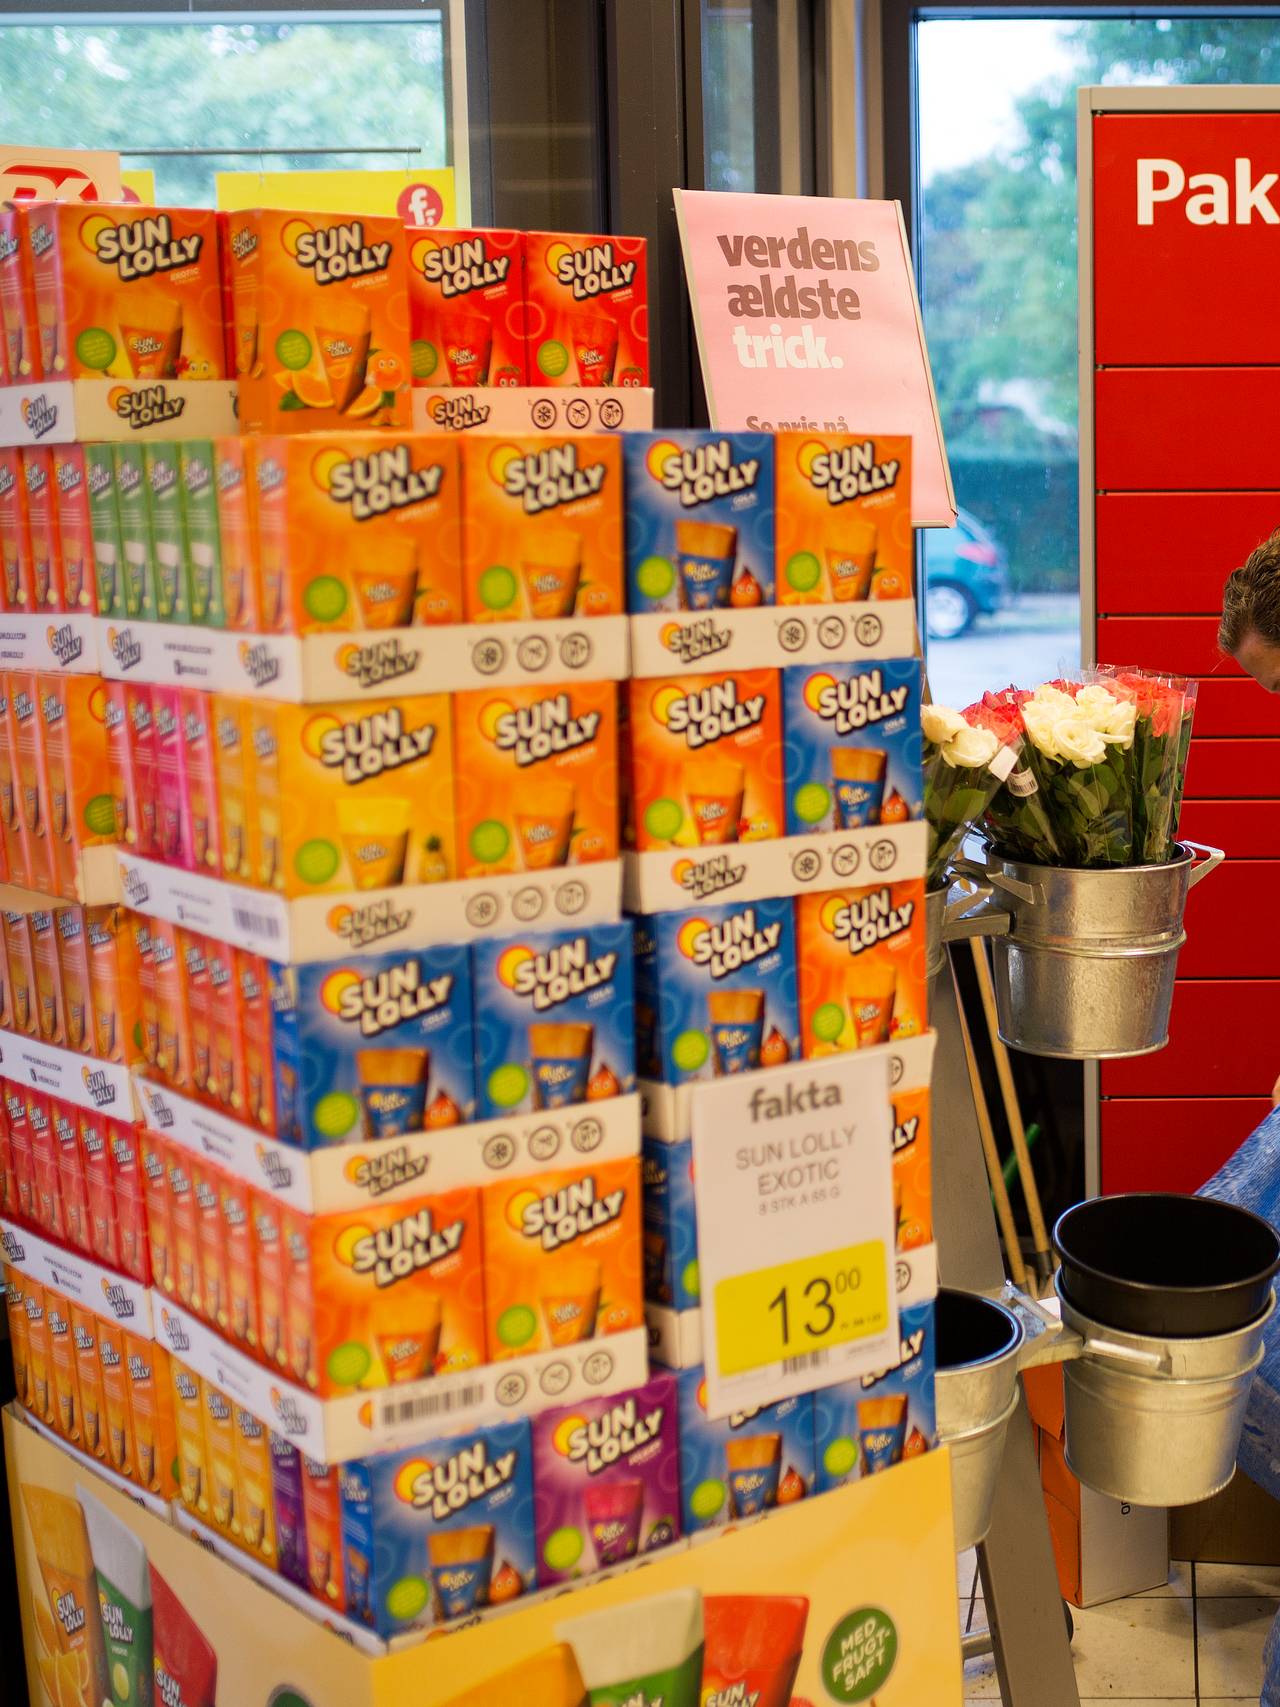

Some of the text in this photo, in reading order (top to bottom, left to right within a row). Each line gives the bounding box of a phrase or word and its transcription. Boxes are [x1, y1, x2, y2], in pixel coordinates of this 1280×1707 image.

[96, 214, 170, 264] SUN
[118, 234, 202, 282] LOLLY
[296, 221, 362, 267] SUN
[423, 237, 484, 282] SUN
[717, 226, 880, 272] verdens
[314, 242, 391, 285] LOLLY
[441, 256, 509, 298] LOLLY
[558, 243, 612, 284] SUN
[573, 262, 636, 300] LOLLY
[727, 274, 861, 320] ældste
[732, 324, 844, 369] trick.
[27, 394, 48, 428] SUN
[31, 405, 57, 439] LOLLY
[116, 385, 165, 418] SUN
[130, 397, 185, 429] LOLLY
[435, 395, 473, 423] SUN
[445, 405, 490, 430] LOLLY
[329, 444, 410, 501] SUN
[503, 443, 577, 496] SUN
[662, 439, 730, 489] SUN
[679, 459, 759, 508] LOLLY
[811, 441, 874, 487] SUN
[827, 460, 899, 506] LOLLY
[352, 465, 443, 521] LOLLY
[522, 464, 606, 515] LOLLY
[50, 624, 71, 653] SUN
[59, 636, 82, 666] LOLLY
[112, 628, 132, 656] SUN
[670, 617, 714, 651] SUN
[680, 629, 732, 663] LOLLY
[121, 642, 141, 671] LOLLY
[347, 638, 399, 677] SUN
[360, 650, 420, 688] LOLLY
[667, 679, 736, 732] SUN
[818, 669, 882, 720] SUN
[835, 686, 907, 735] LOLLY
[321, 706, 402, 767] SUN
[495, 694, 569, 750] SUN
[514, 712, 600, 767] LOLLY
[686, 696, 765, 749] LOLLY
[343, 725, 435, 785] LOLLY
[681, 855, 728, 889] SUN
[692, 865, 746, 899] LOLLY
[339, 900, 391, 938] SUN
[351, 910, 413, 948] LOLLY
[834, 888, 890, 939] SUN
[849, 902, 913, 955] LOLLY
[692, 910, 756, 965] SUN
[710, 923, 780, 979] LOLLY
[513, 938, 588, 995] SUN
[532, 953, 617, 1011] LOLLY
[339, 959, 420, 1019] SUN
[361, 975, 453, 1038] LOLLY
[87, 1070, 105, 1093] SUN
[93, 1084, 115, 1107] LOLLY
[748, 1080, 842, 1122] fakta
[83, 1128, 97, 1143] SUN
[86, 1136, 103, 1152] LOLLY
[113, 1139, 127, 1155] SUN
[116, 1148, 133, 1163] LOLLY
[736, 1141, 782, 1170] SUN
[789, 1124, 857, 1159] LOLLY
[355, 1147, 407, 1187] SUN
[369, 1155, 429, 1196] LOLLY
[758, 1158, 839, 1196] EXOTIC
[522, 1176, 596, 1238] SUN
[542, 1191, 623, 1253] LOLLY
[771, 1197, 795, 1213] STK
[352, 1208, 432, 1274] SUN
[375, 1221, 463, 1289] LOLLY
[106, 1283, 126, 1305] SUN
[113, 1296, 135, 1318] LOLLY
[769, 1276, 835, 1345] 13
[835, 1268, 861, 1294] 00
[166, 1316, 182, 1338] SUN
[171, 1329, 189, 1351] LOLLY
[101, 1343, 113, 1358] SUN
[103, 1351, 120, 1365] LOLLY
[128, 1355, 142, 1372] SUN
[131, 1366, 150, 1379] LOLLY
[176, 1374, 190, 1390] SUN
[179, 1384, 197, 1399] LOLLY
[568, 1400, 636, 1461] SUN
[587, 1408, 662, 1474] LOLLY
[412, 1441, 485, 1508] SUN
[432, 1451, 516, 1521] LOLLY
[57, 1592, 75, 1622] SUN
[64, 1607, 85, 1636] LOLLY
[103, 1603, 124, 1627] SUN
[109, 1621, 133, 1645] LOLLY
[841, 1617, 877, 1655] MED
[831, 1628, 891, 1683] FRUGT-
[844, 1649, 885, 1692] SAFT
[156, 1670, 180, 1696] SUN
